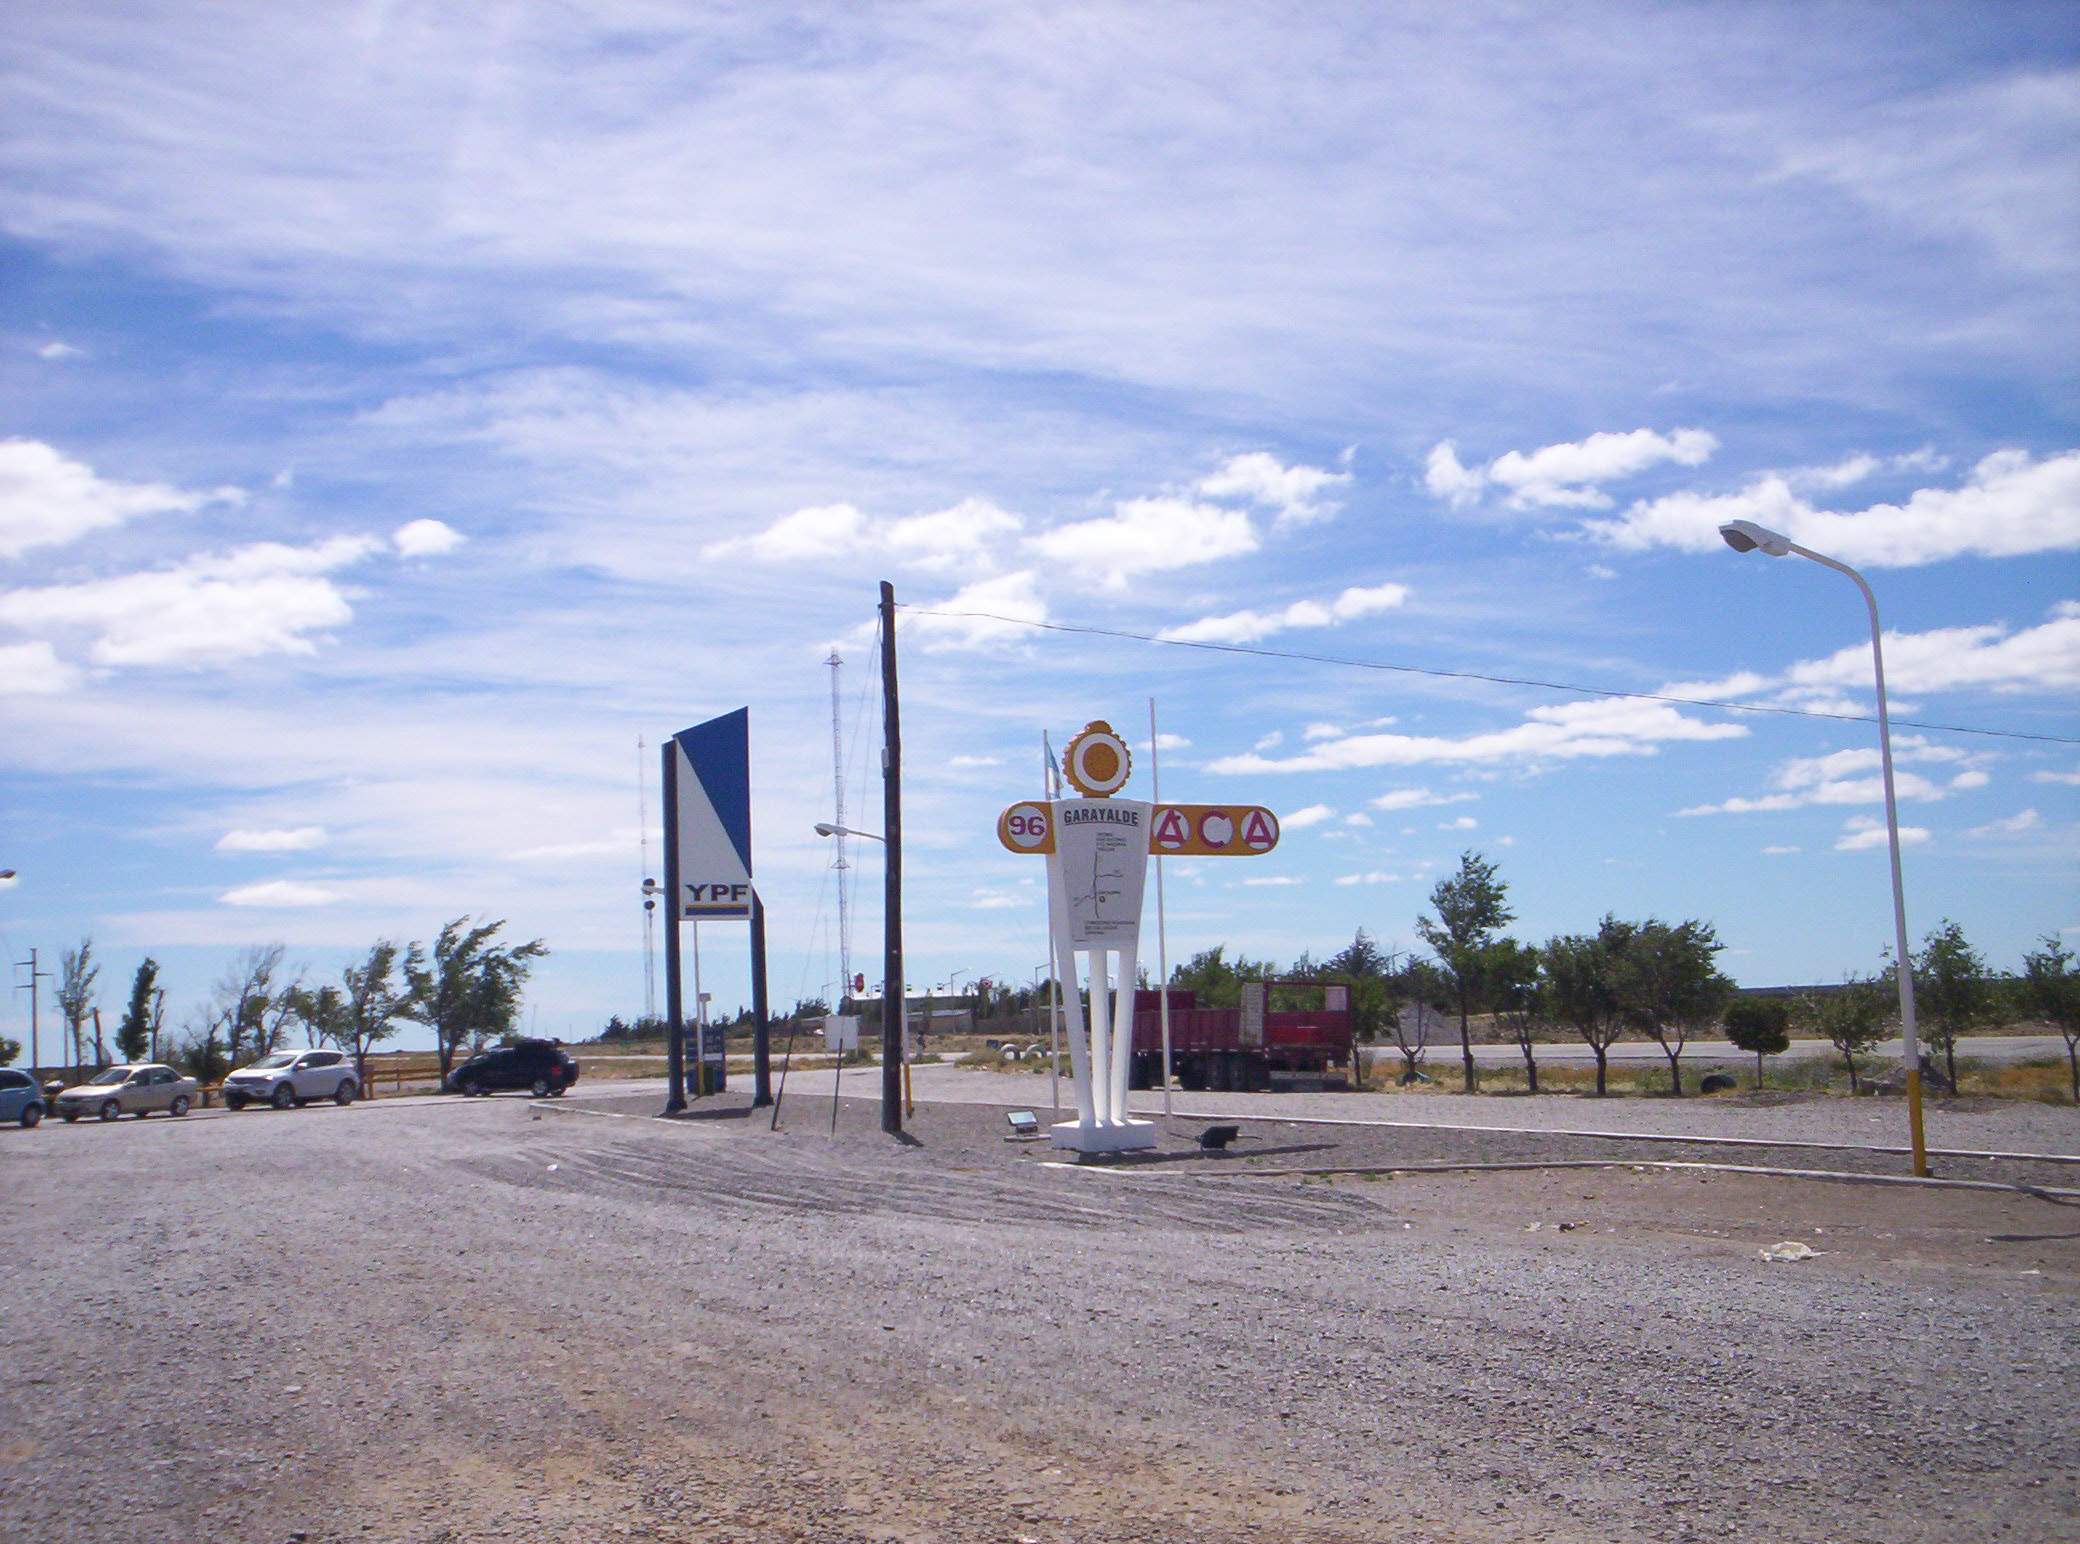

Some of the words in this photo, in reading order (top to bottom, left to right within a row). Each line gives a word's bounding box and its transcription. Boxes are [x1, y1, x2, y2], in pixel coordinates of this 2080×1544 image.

[1008, 815, 1045, 836] 96
[1064, 808, 1139, 825] GARAYALDE
[1157, 808, 1275, 849] ACA
[685, 884, 749, 901] YPF
